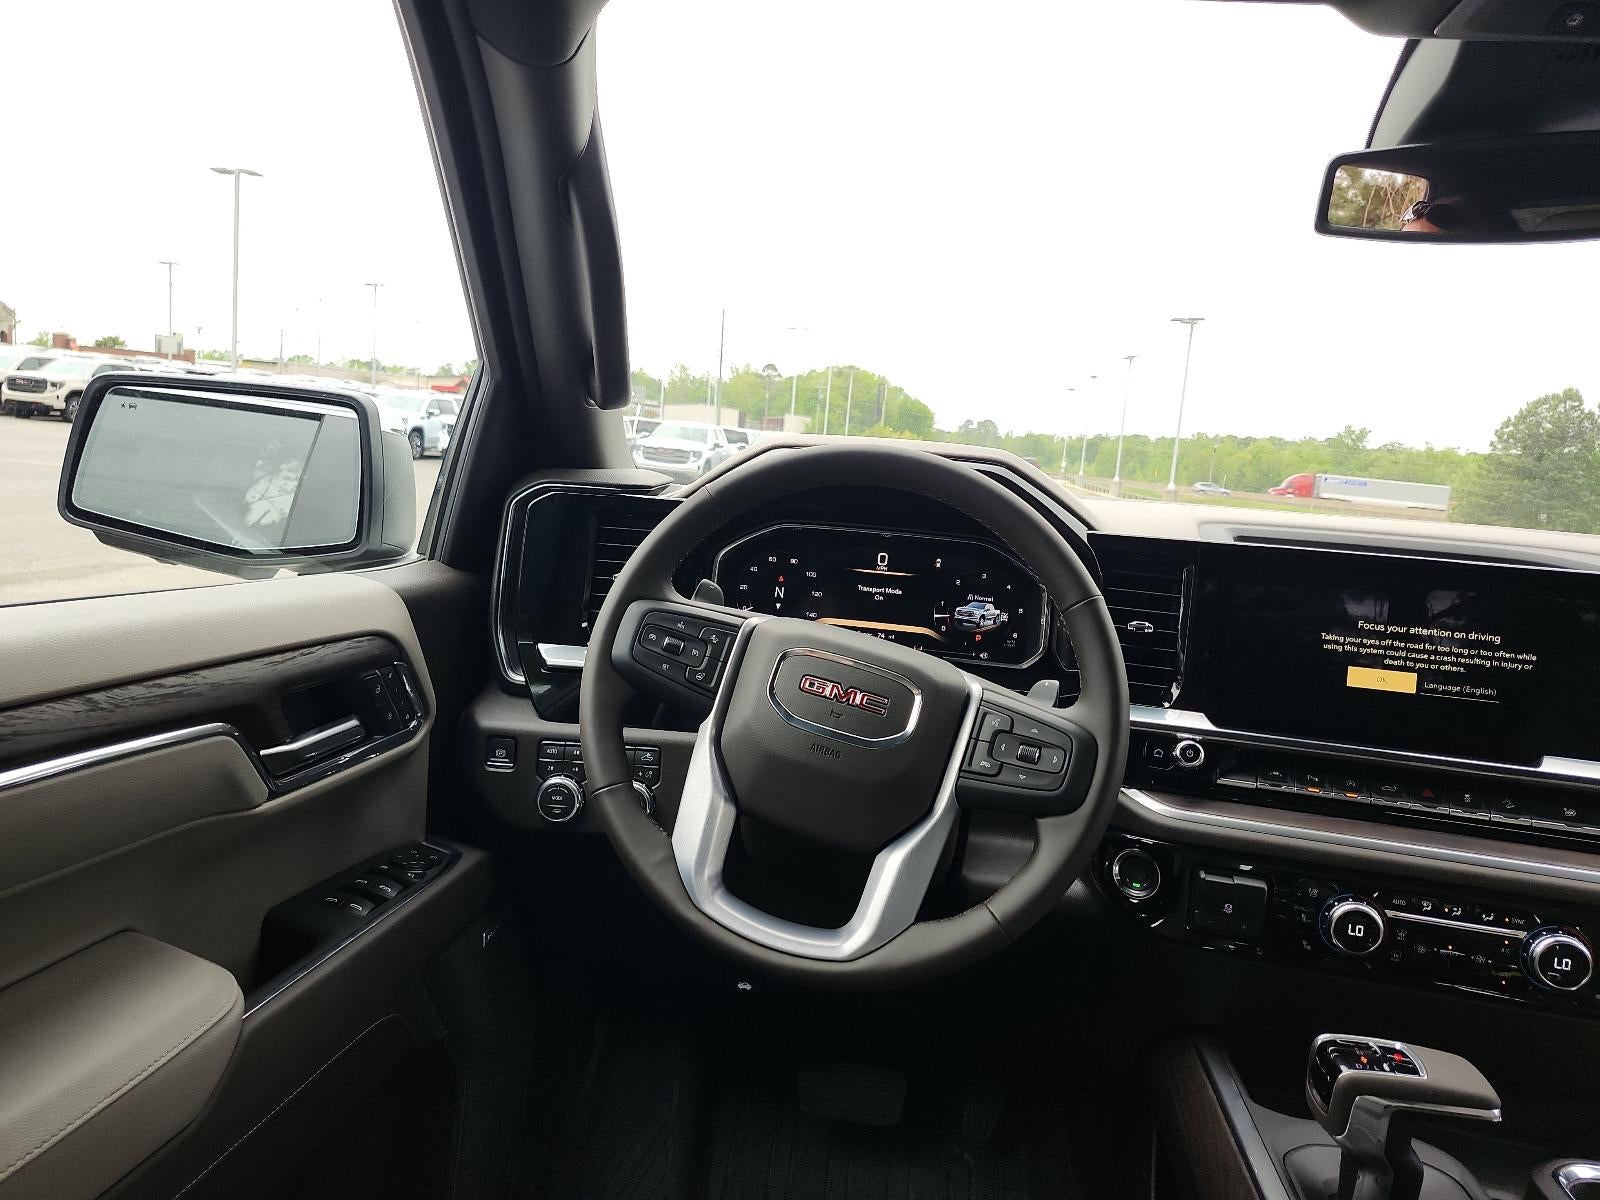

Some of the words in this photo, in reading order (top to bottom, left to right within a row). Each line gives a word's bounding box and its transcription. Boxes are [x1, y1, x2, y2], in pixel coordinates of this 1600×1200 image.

[774, 586, 785, 599] N
[858, 584, 885, 593] Transport
[885, 587, 903, 595] Mode
[1357, 620, 1385, 631] Focus
[1386, 625, 1408, 634] your
[1409, 627, 1452, 638] attention
[1454, 631, 1466, 639] on
[1468, 631, 1501, 645] driving
[1321, 632, 1344, 643] Taking
[1362, 638, 1380, 646] eyes
[1393, 640, 1405, 648] the
[1406, 642, 1424, 650] road
[1425, 643, 1436, 651] for
[1437, 645, 1450, 653] too
[1451, 646, 1469, 655] long
[1480, 649, 1493, 657] too
[1494, 651, 1515, 659] often
[1516, 653, 1537, 661] while
[1323, 643, 1343, 652] using
[1359, 647, 1385, 655] system
[1386, 649, 1406, 657] could
[1436, 655, 1457, 663] crash
[1457, 656, 1491, 668] resulting
[1501, 661, 1523, 671] injury
[1383, 658, 1405, 667] death
[1415, 662, 1429, 670] you
[1440, 664, 1467, 673] others.
[1376, 676, 1388, 684] OK
[799, 674, 889, 717] GMC
[1424, 681, 1461, 693] Language
[1462, 685, 1497, 697] (English)
[809, 742, 841, 759] AIRBAG
[1392, 898, 1407, 906] AUTO
